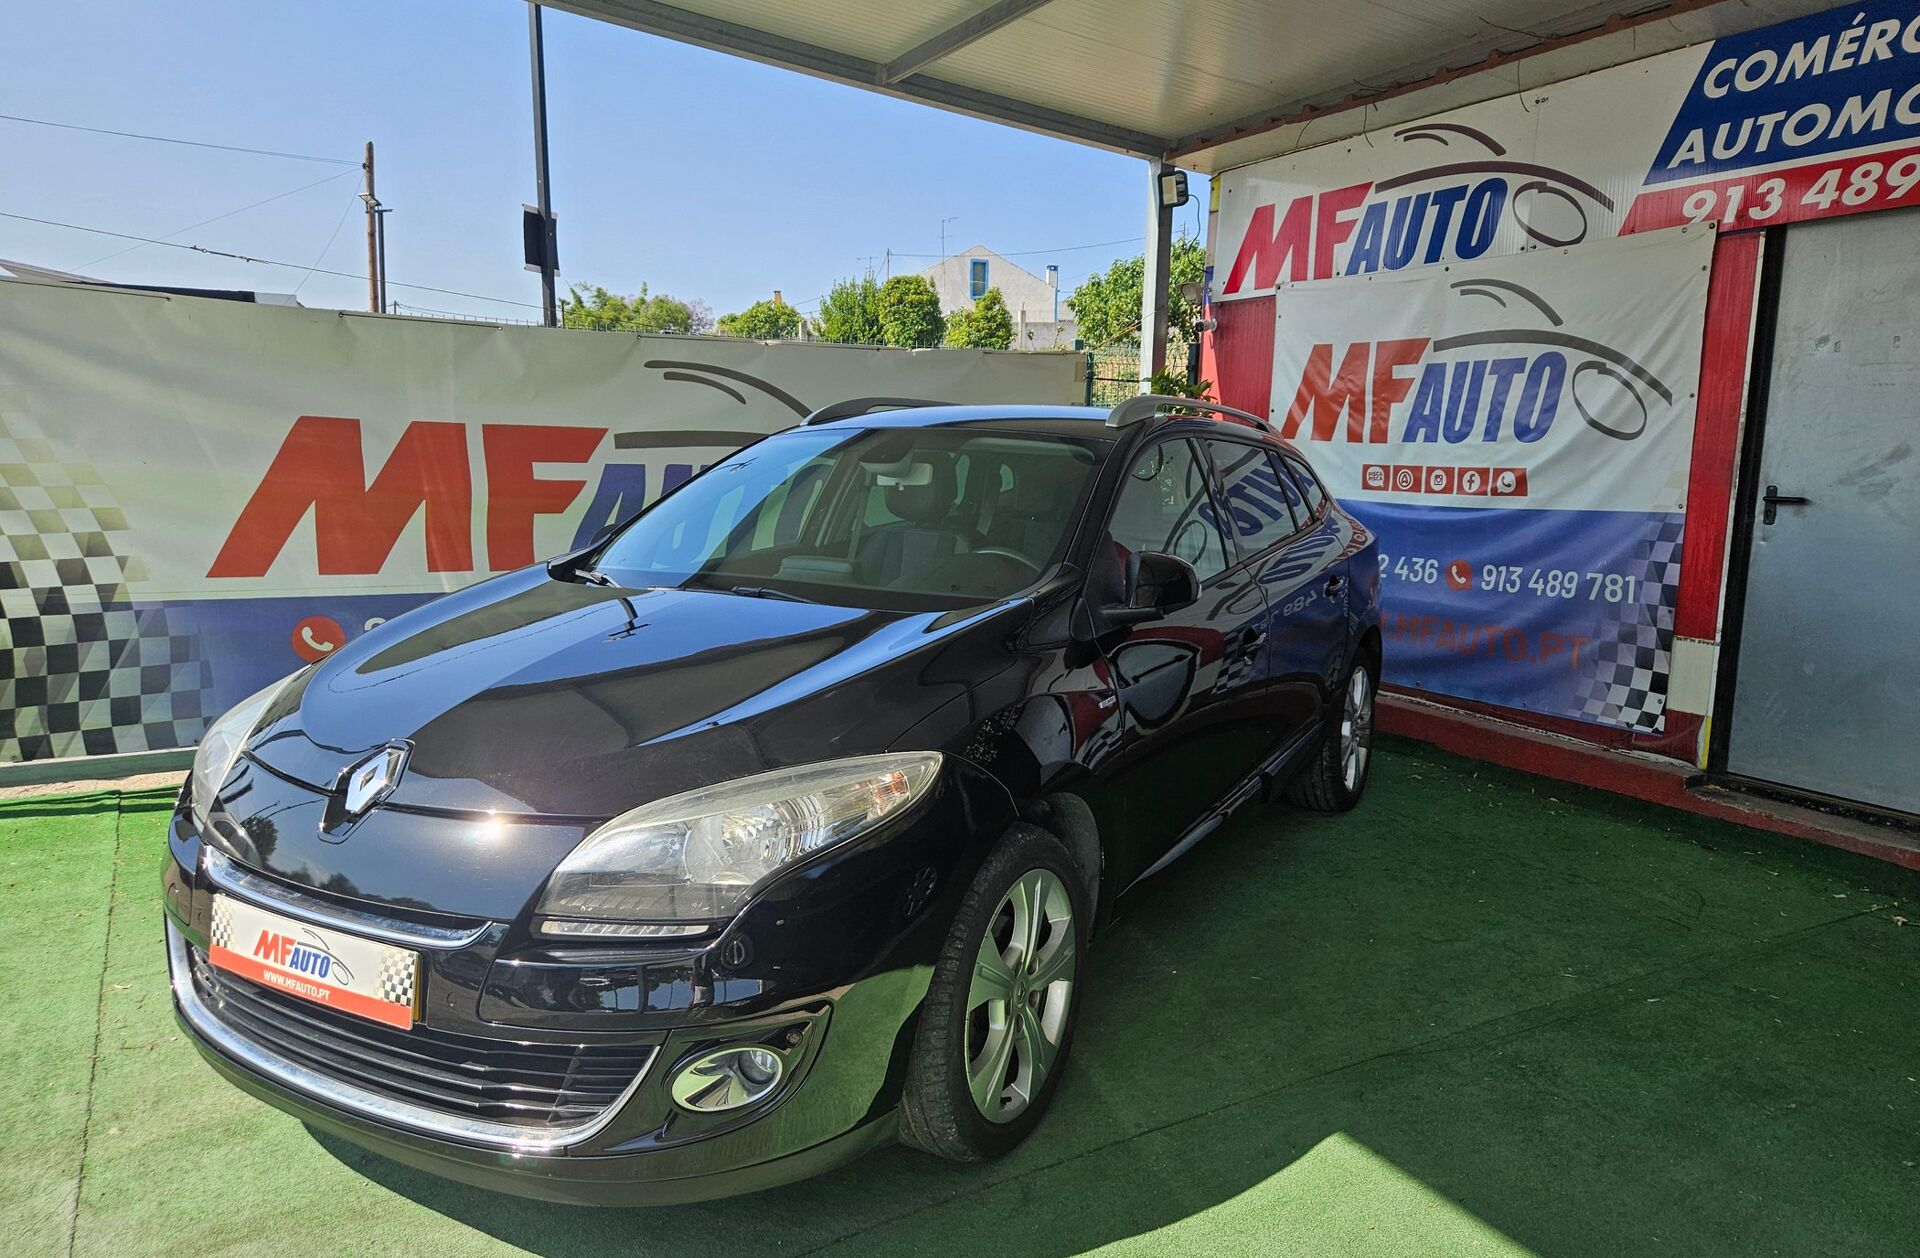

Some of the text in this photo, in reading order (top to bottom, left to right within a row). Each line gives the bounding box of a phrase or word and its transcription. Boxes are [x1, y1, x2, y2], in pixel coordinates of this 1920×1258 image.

[1682, 153, 1920, 225] 913 489
[1394, 556, 1438, 584] 436
[1481, 564, 1523, 593] 913
[1528, 568, 1579, 599] 489
[1585, 572, 1636, 604] 781
[264, 970, 331, 1000] WWW.MFAUTO.PT
